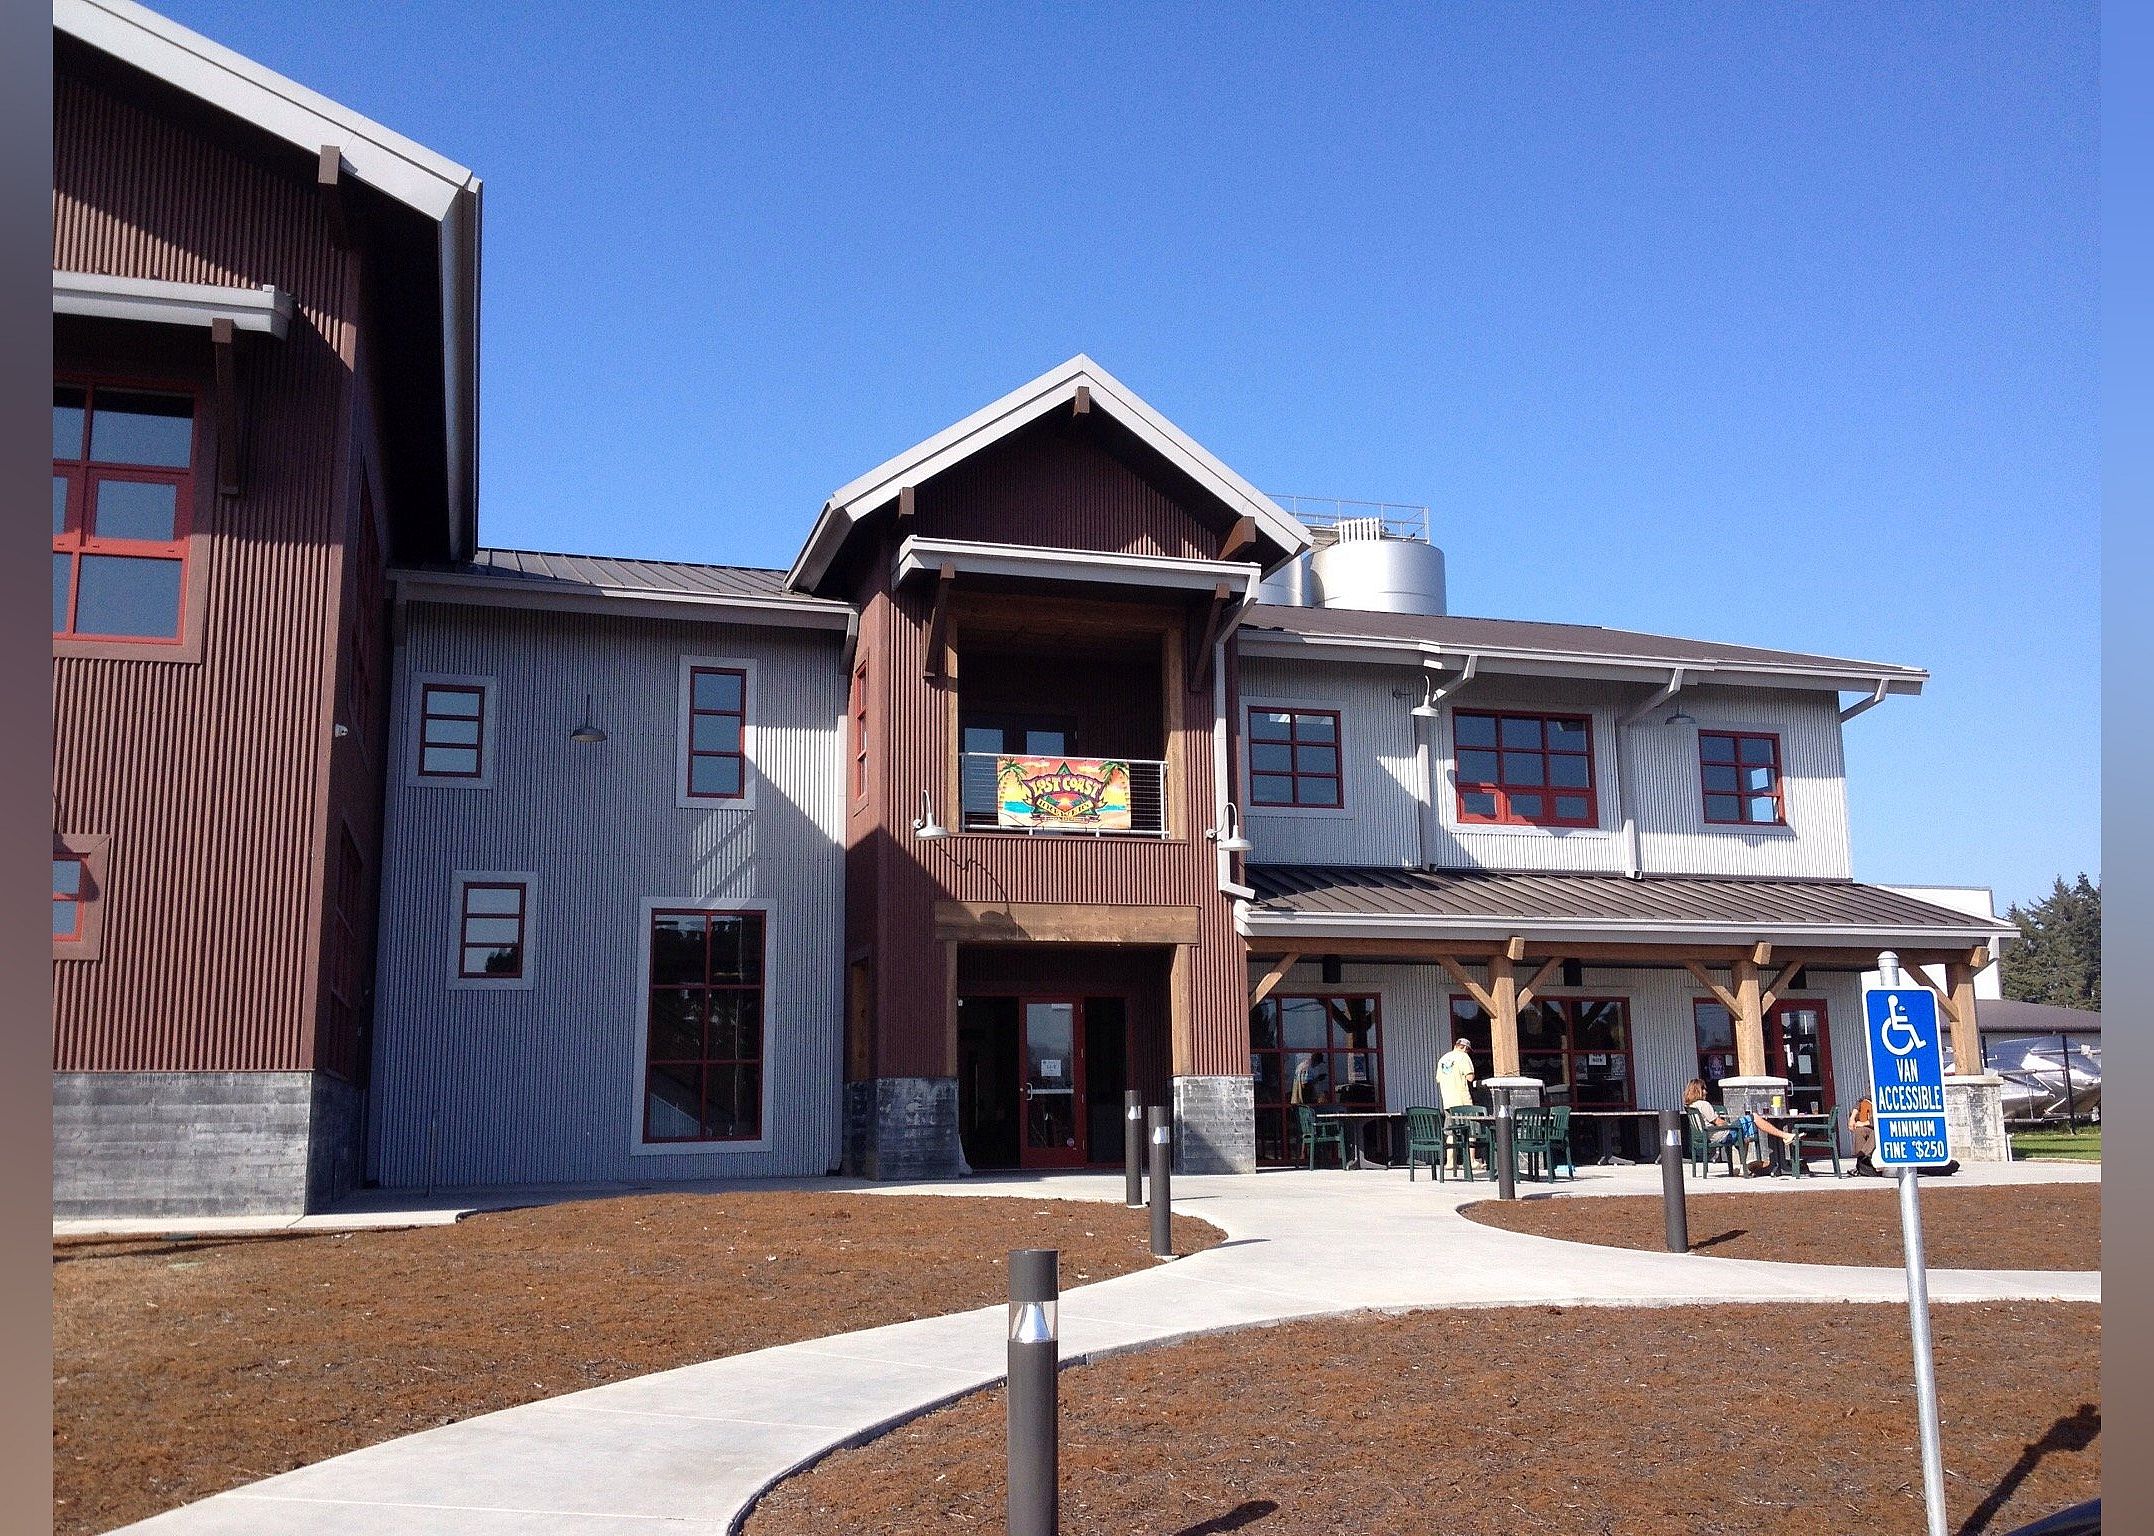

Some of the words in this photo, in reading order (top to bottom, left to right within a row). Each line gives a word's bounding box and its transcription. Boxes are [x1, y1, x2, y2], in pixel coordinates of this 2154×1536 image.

[1033, 777, 1061, 796] LOST
[1063, 777, 1101, 797] COAST
[1896, 1059, 1918, 1082] VAN
[1879, 1086, 1942, 1110] ACCESSIBLE
[1890, 1121, 1935, 1137] MINIMUM
[1884, 1142, 1907, 1159] FINE
[1915, 1141, 1945, 1159] $250
